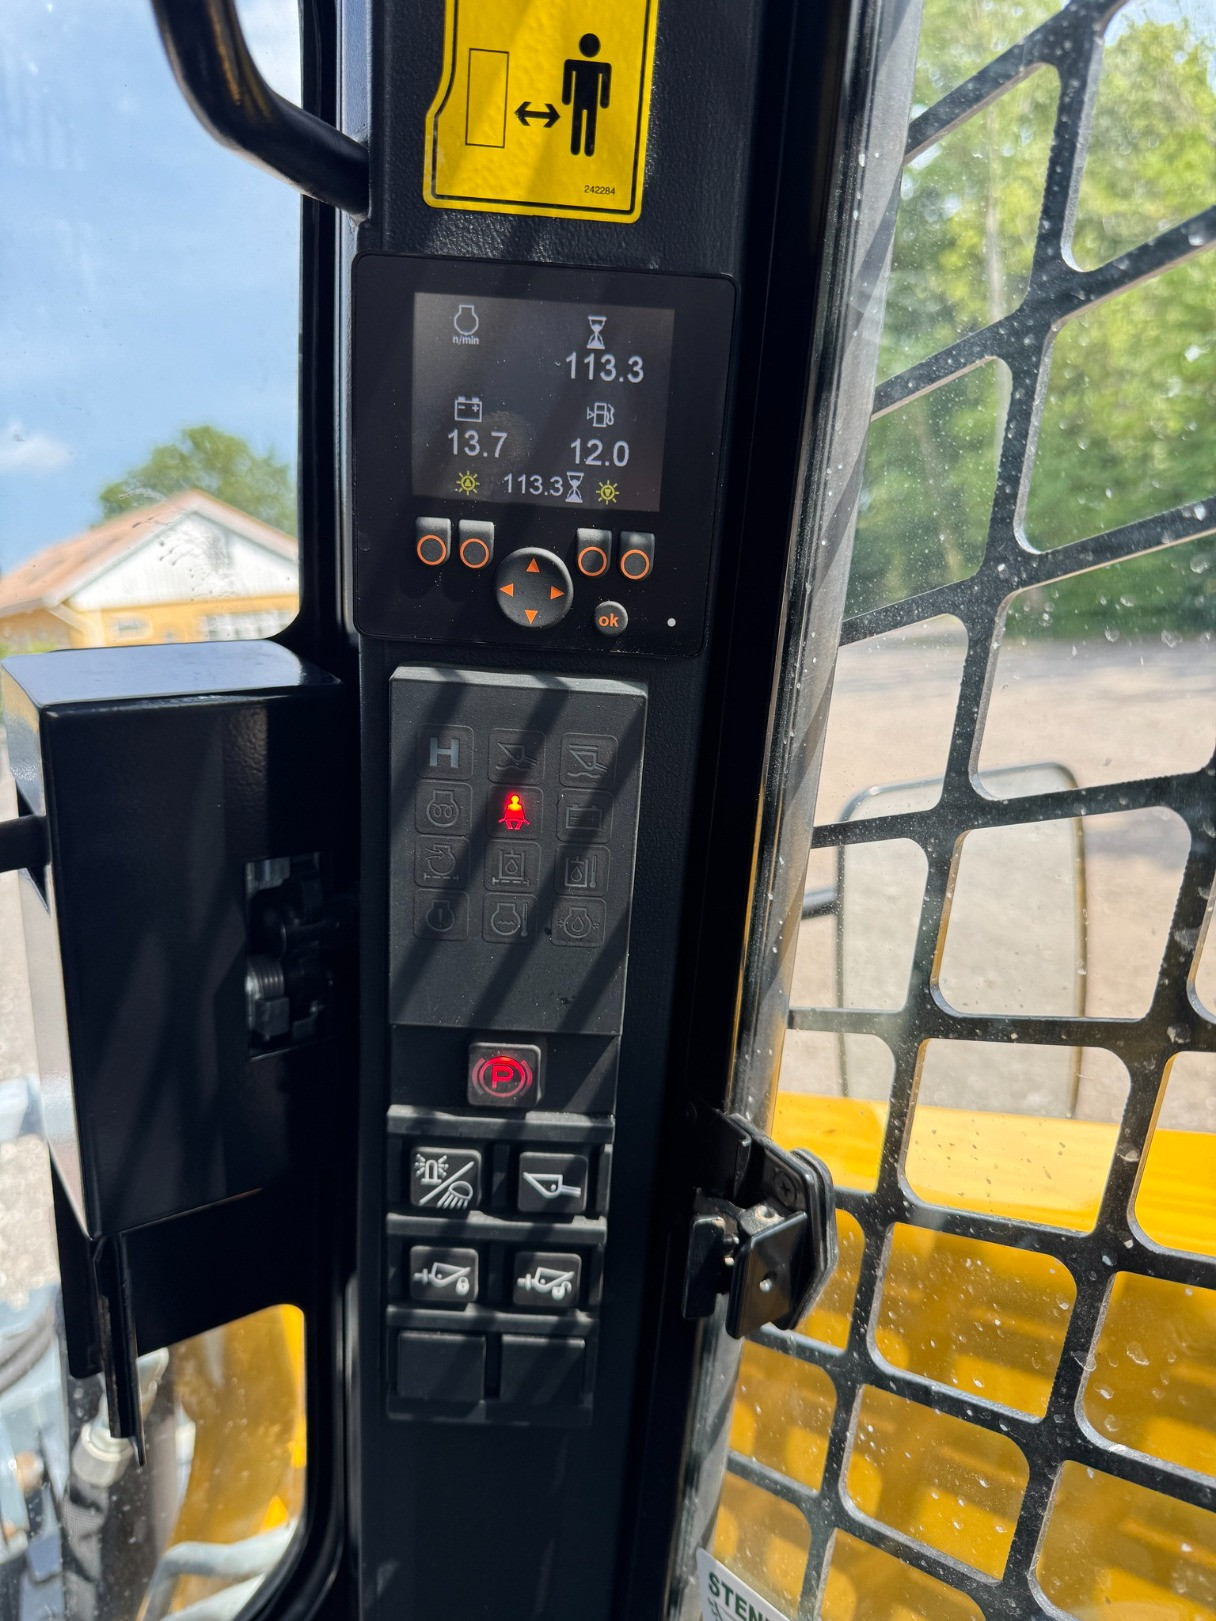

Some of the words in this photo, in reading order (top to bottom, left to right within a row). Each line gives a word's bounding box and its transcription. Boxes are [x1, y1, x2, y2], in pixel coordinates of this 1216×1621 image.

[584, 184, 616, 196] 242284
[452, 335, 480, 345] n/min
[565, 352, 645, 384] 113.3
[448, 429, 508, 459] 13.7
[570, 438, 630, 468] 12.0
[503, 473, 564, 497] 113.3
[598, 613, 619, 628] ok
[429, 737, 461, 769] H
[491, 1065, 514, 1089] P
[708, 1571, 772, 1621] STEN
